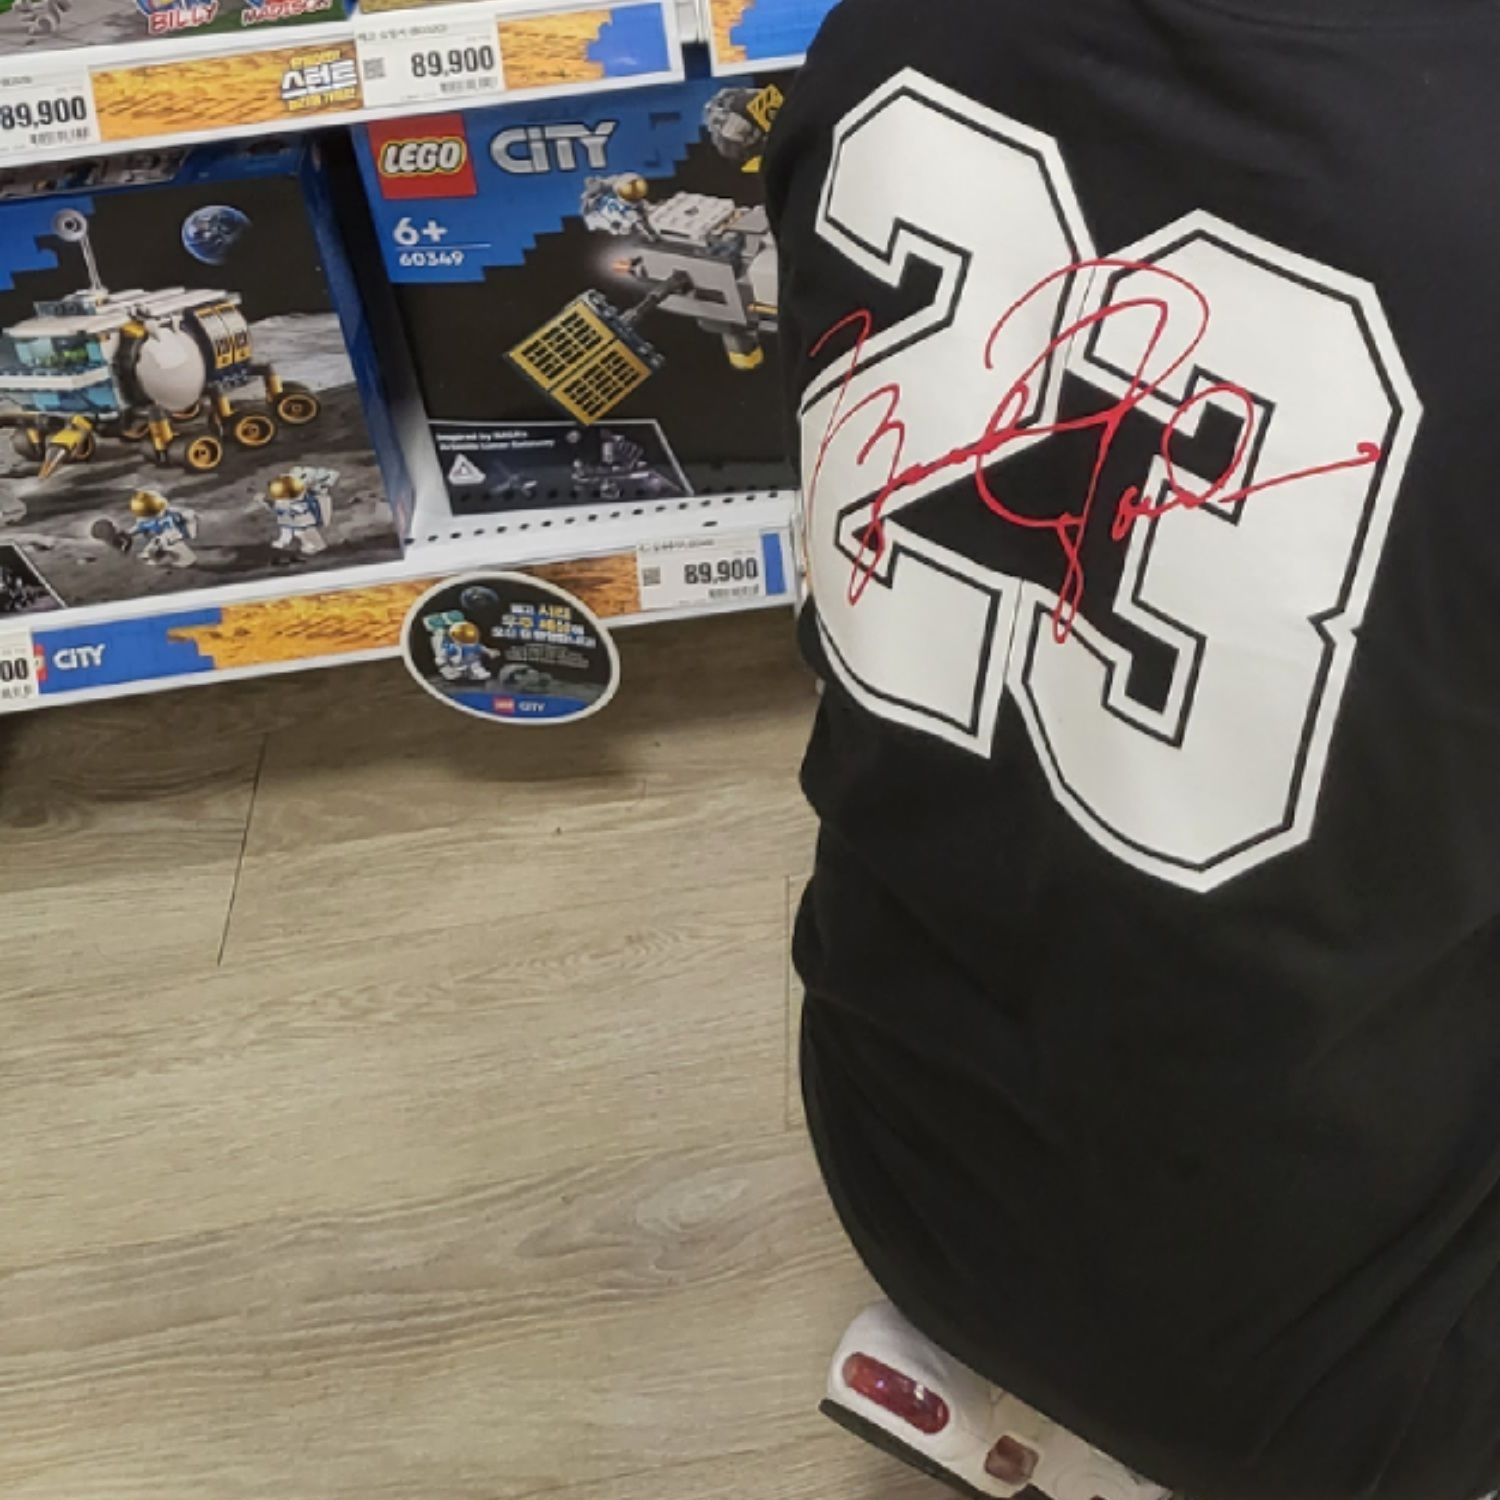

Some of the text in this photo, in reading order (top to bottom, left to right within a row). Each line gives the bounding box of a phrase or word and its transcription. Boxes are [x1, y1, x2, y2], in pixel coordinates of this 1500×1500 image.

[150, 1, 218, 33] BILLY
[411, 45, 496, 79] 89,900
[281, 59, 357, 101] 스턴트
[0, 96, 87, 131] 89,900
[378, 120, 620, 178] LEGO CITY
[393, 217, 448, 246] 6+
[398, 250, 465, 267] 60349
[797, 66, 1424, 893] 23
[683, 557, 760, 585] 89,900
[52, 643, 106, 670] CITY
